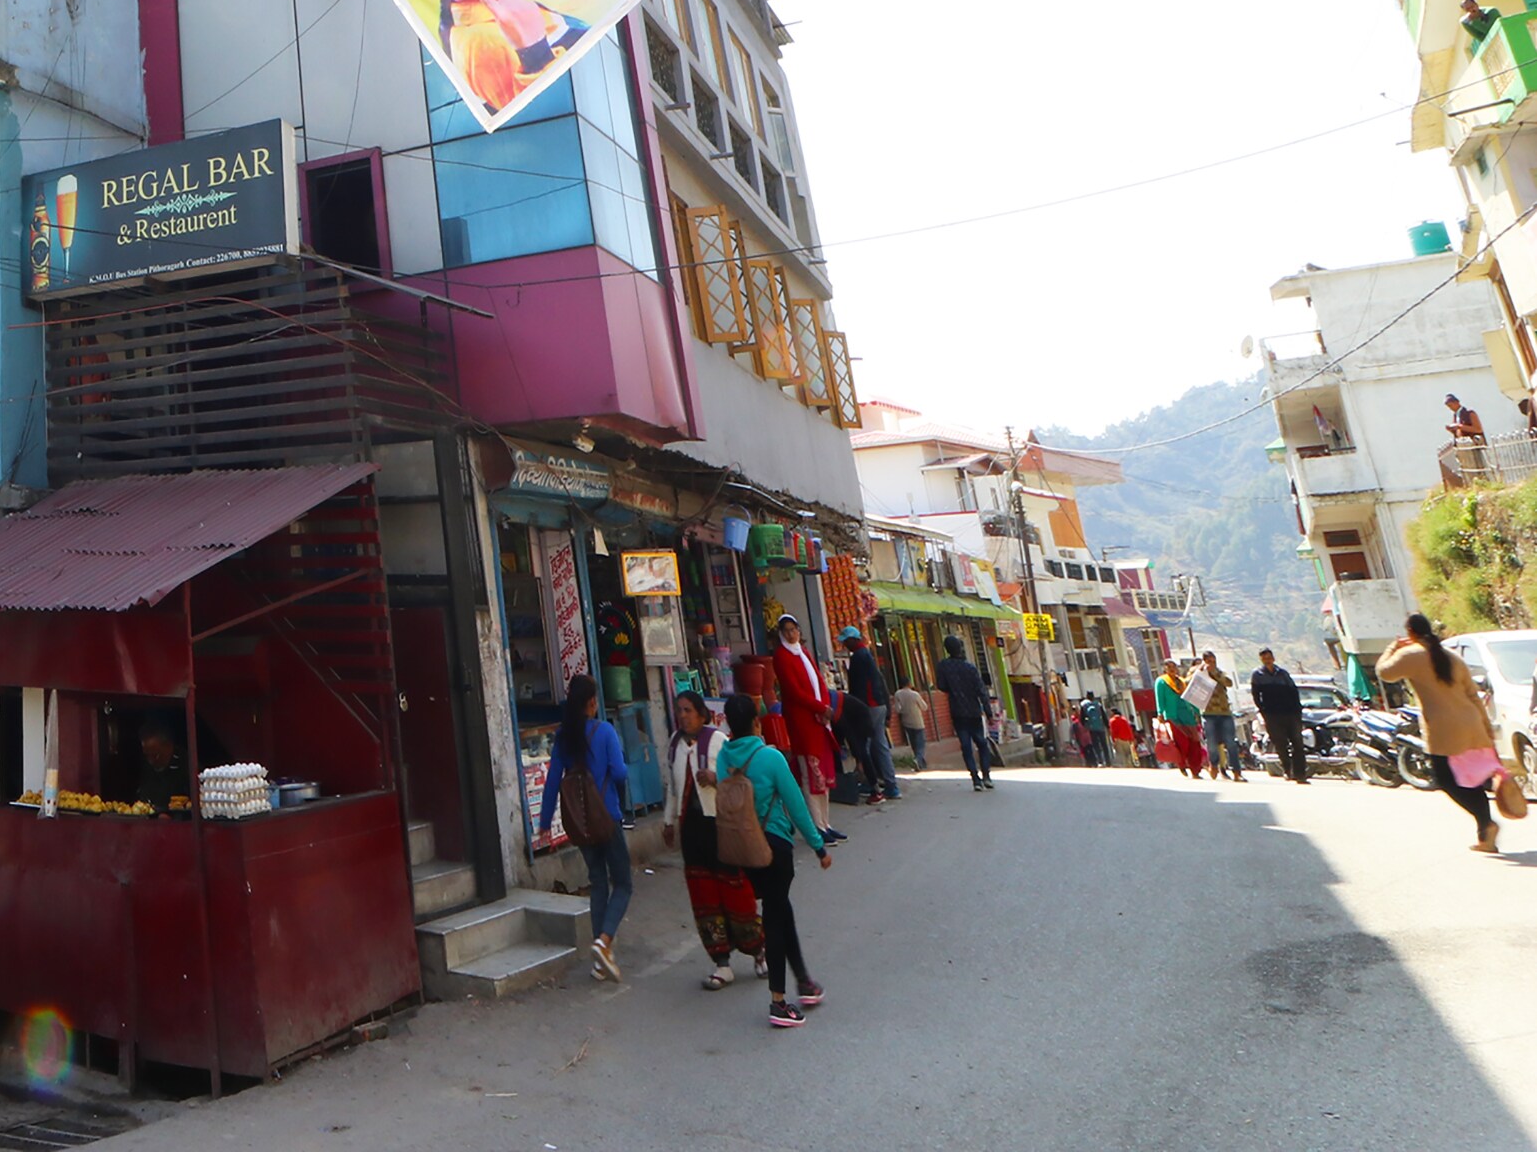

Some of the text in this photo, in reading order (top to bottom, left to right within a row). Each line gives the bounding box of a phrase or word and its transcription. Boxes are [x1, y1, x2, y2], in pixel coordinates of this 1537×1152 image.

[100, 147, 275, 210] REGAL BAR
[117, 204, 239, 246] & Restaurent
[127, 267, 148, 278] Station
[148, 260, 185, 275] Pithoragarh
[186, 256, 216, 269] Contact:
